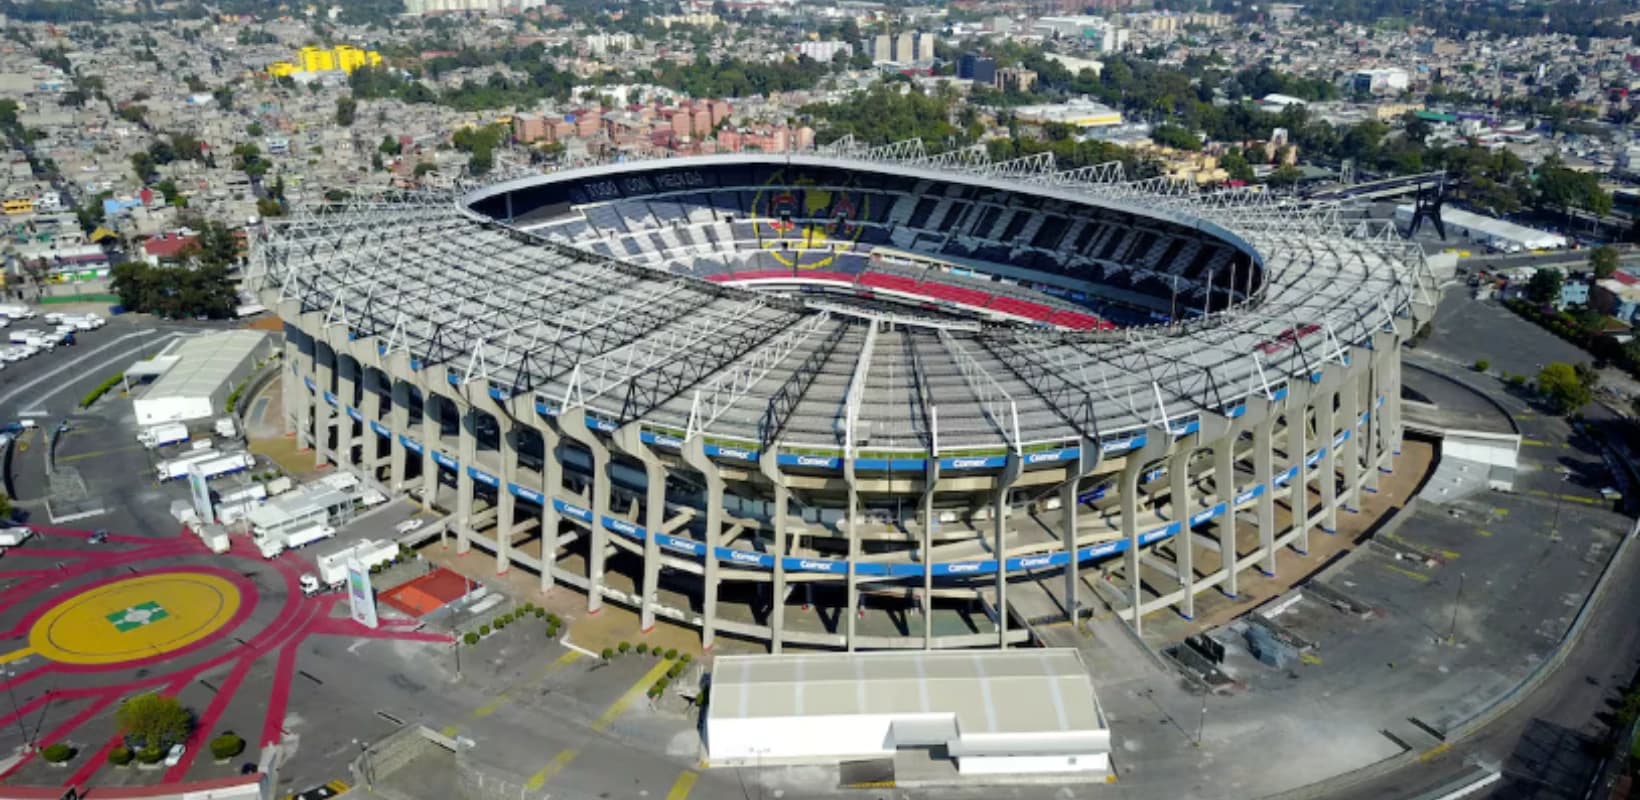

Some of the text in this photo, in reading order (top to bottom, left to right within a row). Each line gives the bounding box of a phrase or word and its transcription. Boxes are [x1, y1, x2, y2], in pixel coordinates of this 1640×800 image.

[719, 449, 749, 459] Comex
[1030, 451, 1062, 462] Comex
[798, 457, 830, 466] Comex
[954, 459, 987, 467] Comex
[1090, 544, 1118, 556] Comex
[732, 550, 761, 562] Comex
[1021, 555, 1050, 567] Comex
[801, 560, 832, 570] Comex
[949, 562, 981, 572] Comex
